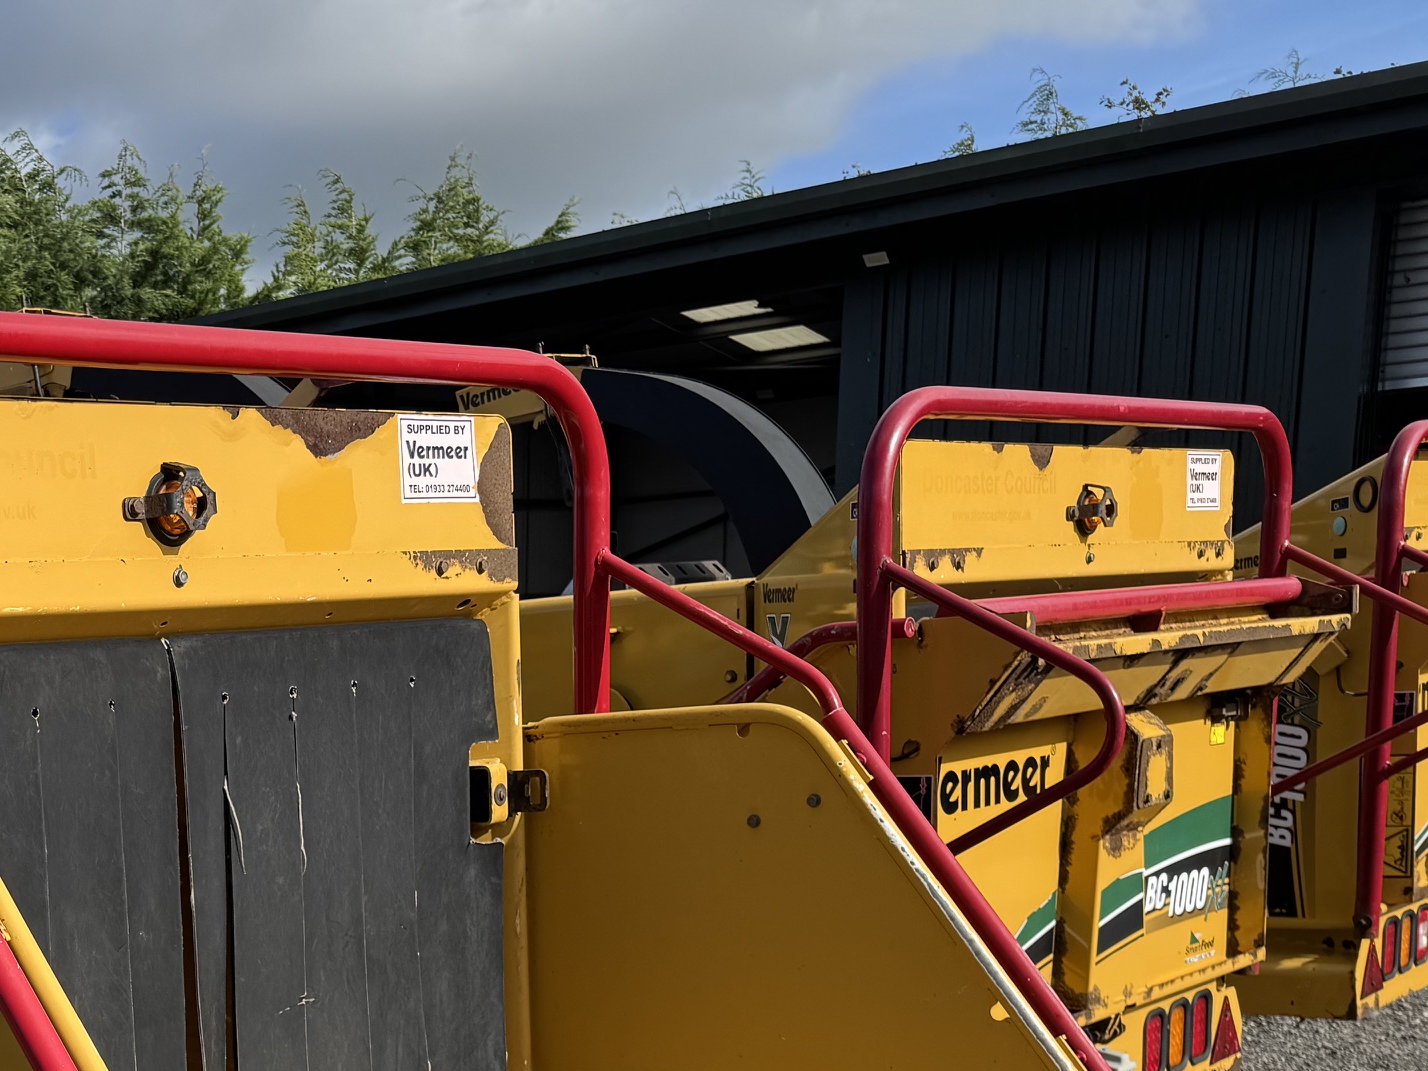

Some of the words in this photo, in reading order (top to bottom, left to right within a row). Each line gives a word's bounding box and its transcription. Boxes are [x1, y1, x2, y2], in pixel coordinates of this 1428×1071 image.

[406, 424, 451, 435] SUPPLIED
[453, 425, 466, 435] BY
[406, 440, 469, 460] Vermeer
[408, 462, 439, 478] (UK)
[1189, 468, 1218, 481] Vermeer
[409, 484, 424, 494] TEL:
[425, 484, 446, 494] 01933
[447, 484, 471, 493] 274400
[1189, 483, 1204, 494] (UK)
[762, 582, 796, 604] Vermeer
[939, 754, 1051, 815] ermeer
